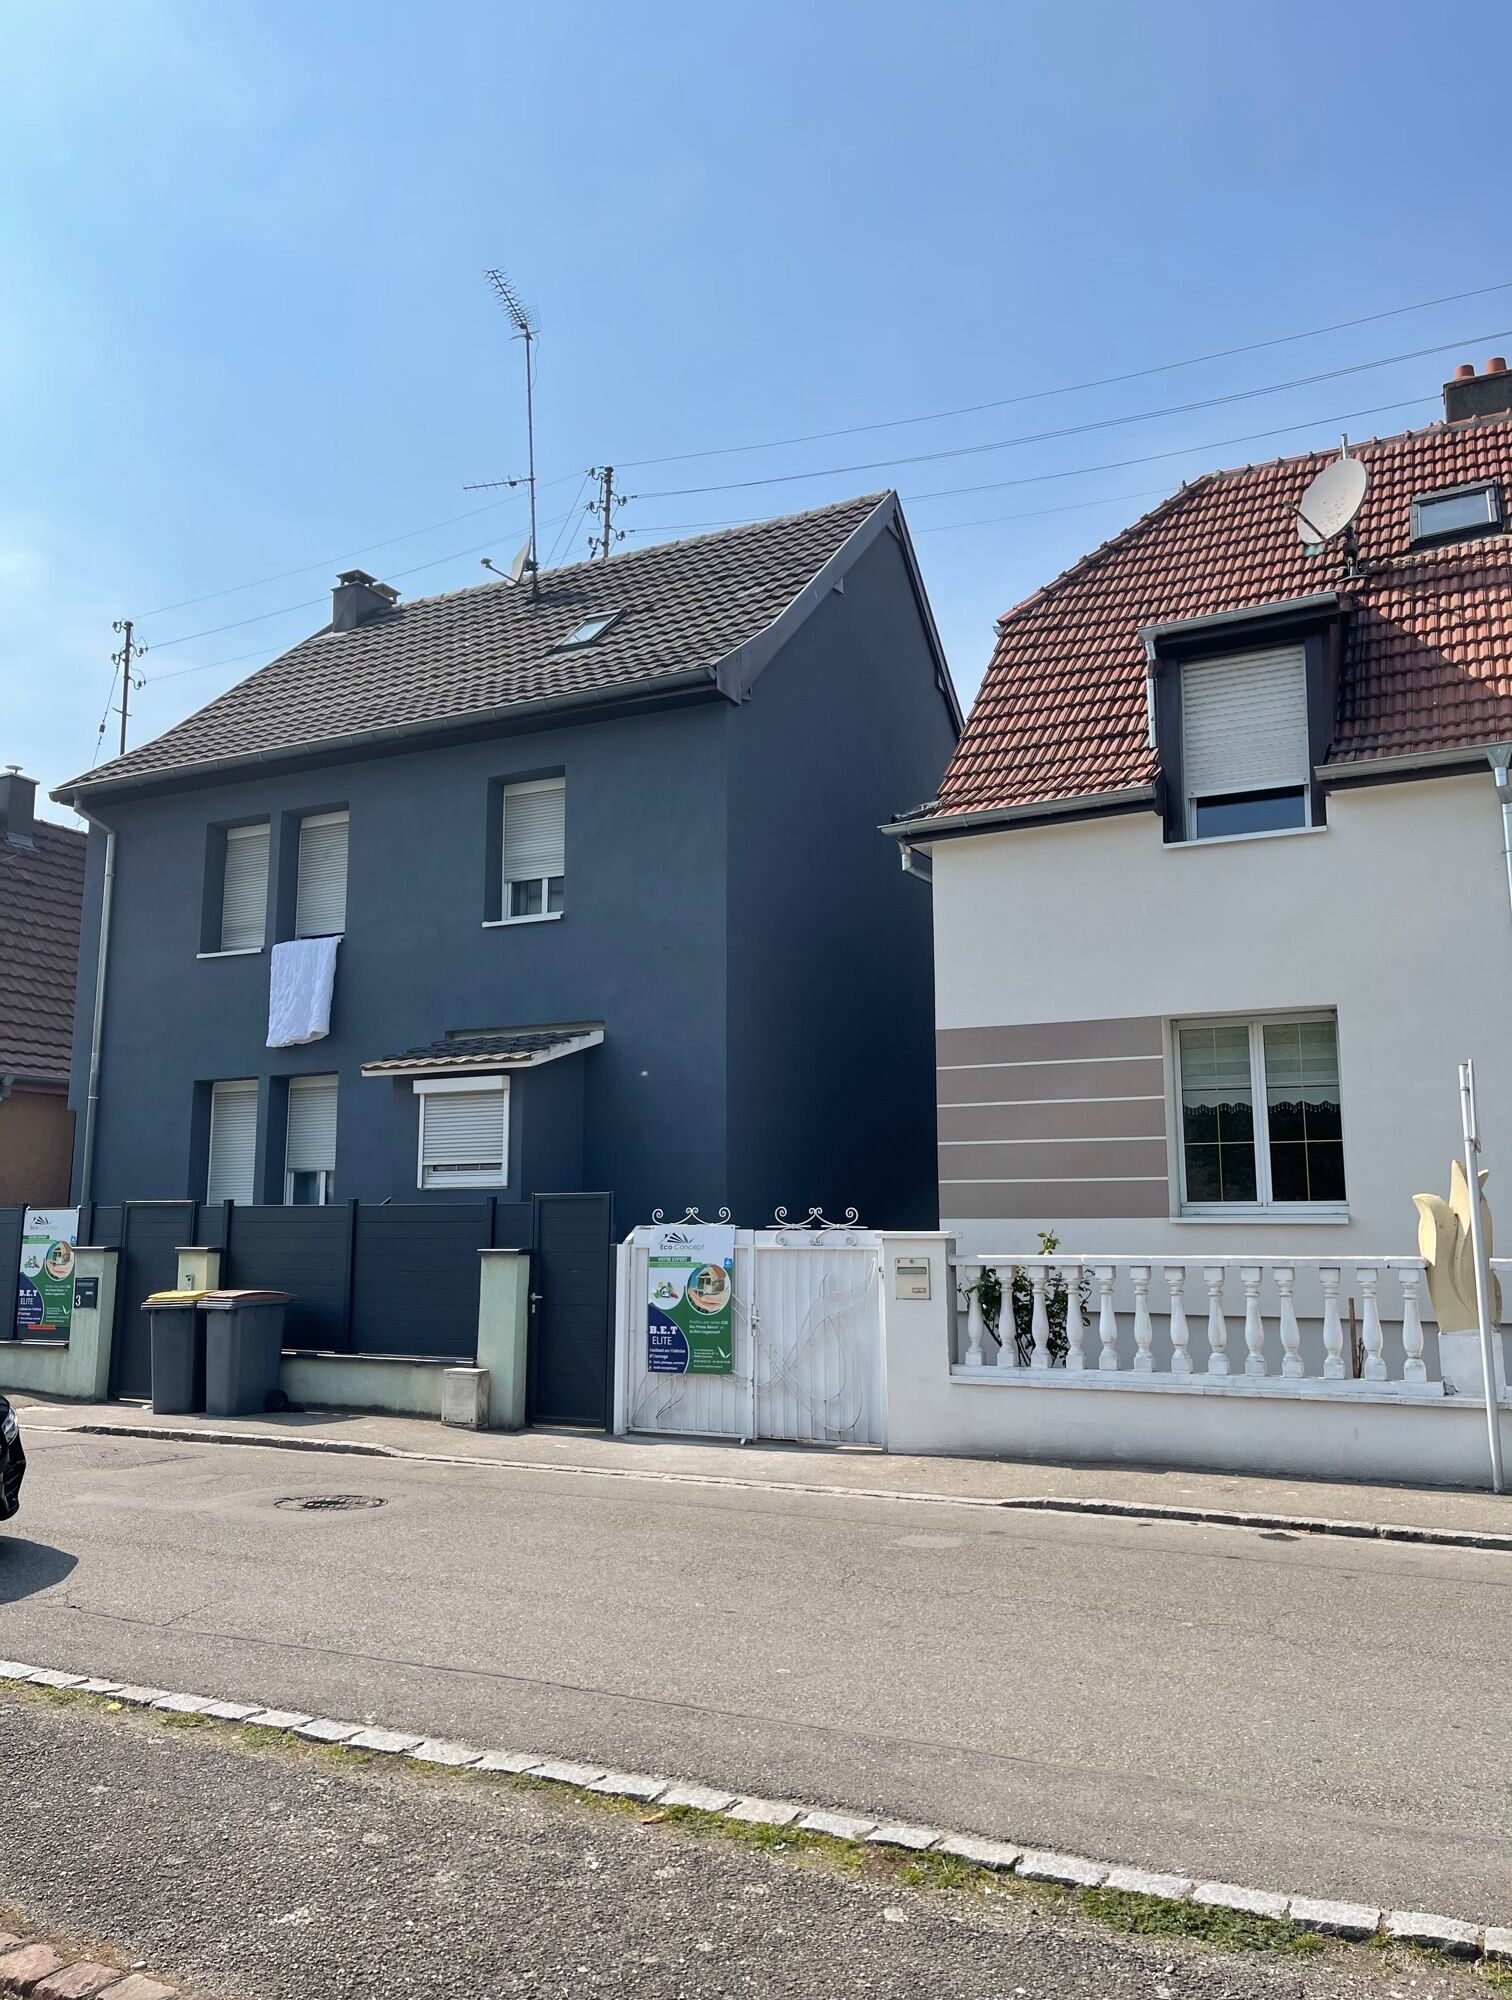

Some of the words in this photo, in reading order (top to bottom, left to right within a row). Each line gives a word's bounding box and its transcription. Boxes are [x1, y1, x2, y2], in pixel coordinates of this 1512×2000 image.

[674, 1243, 704, 1251] Concept
[20, 1297, 34, 1305] ELITE
[75, 1294, 81, 1307] 3
[649, 1325, 678, 1335] B.E.T
[652, 1336, 673, 1345] ELITE
